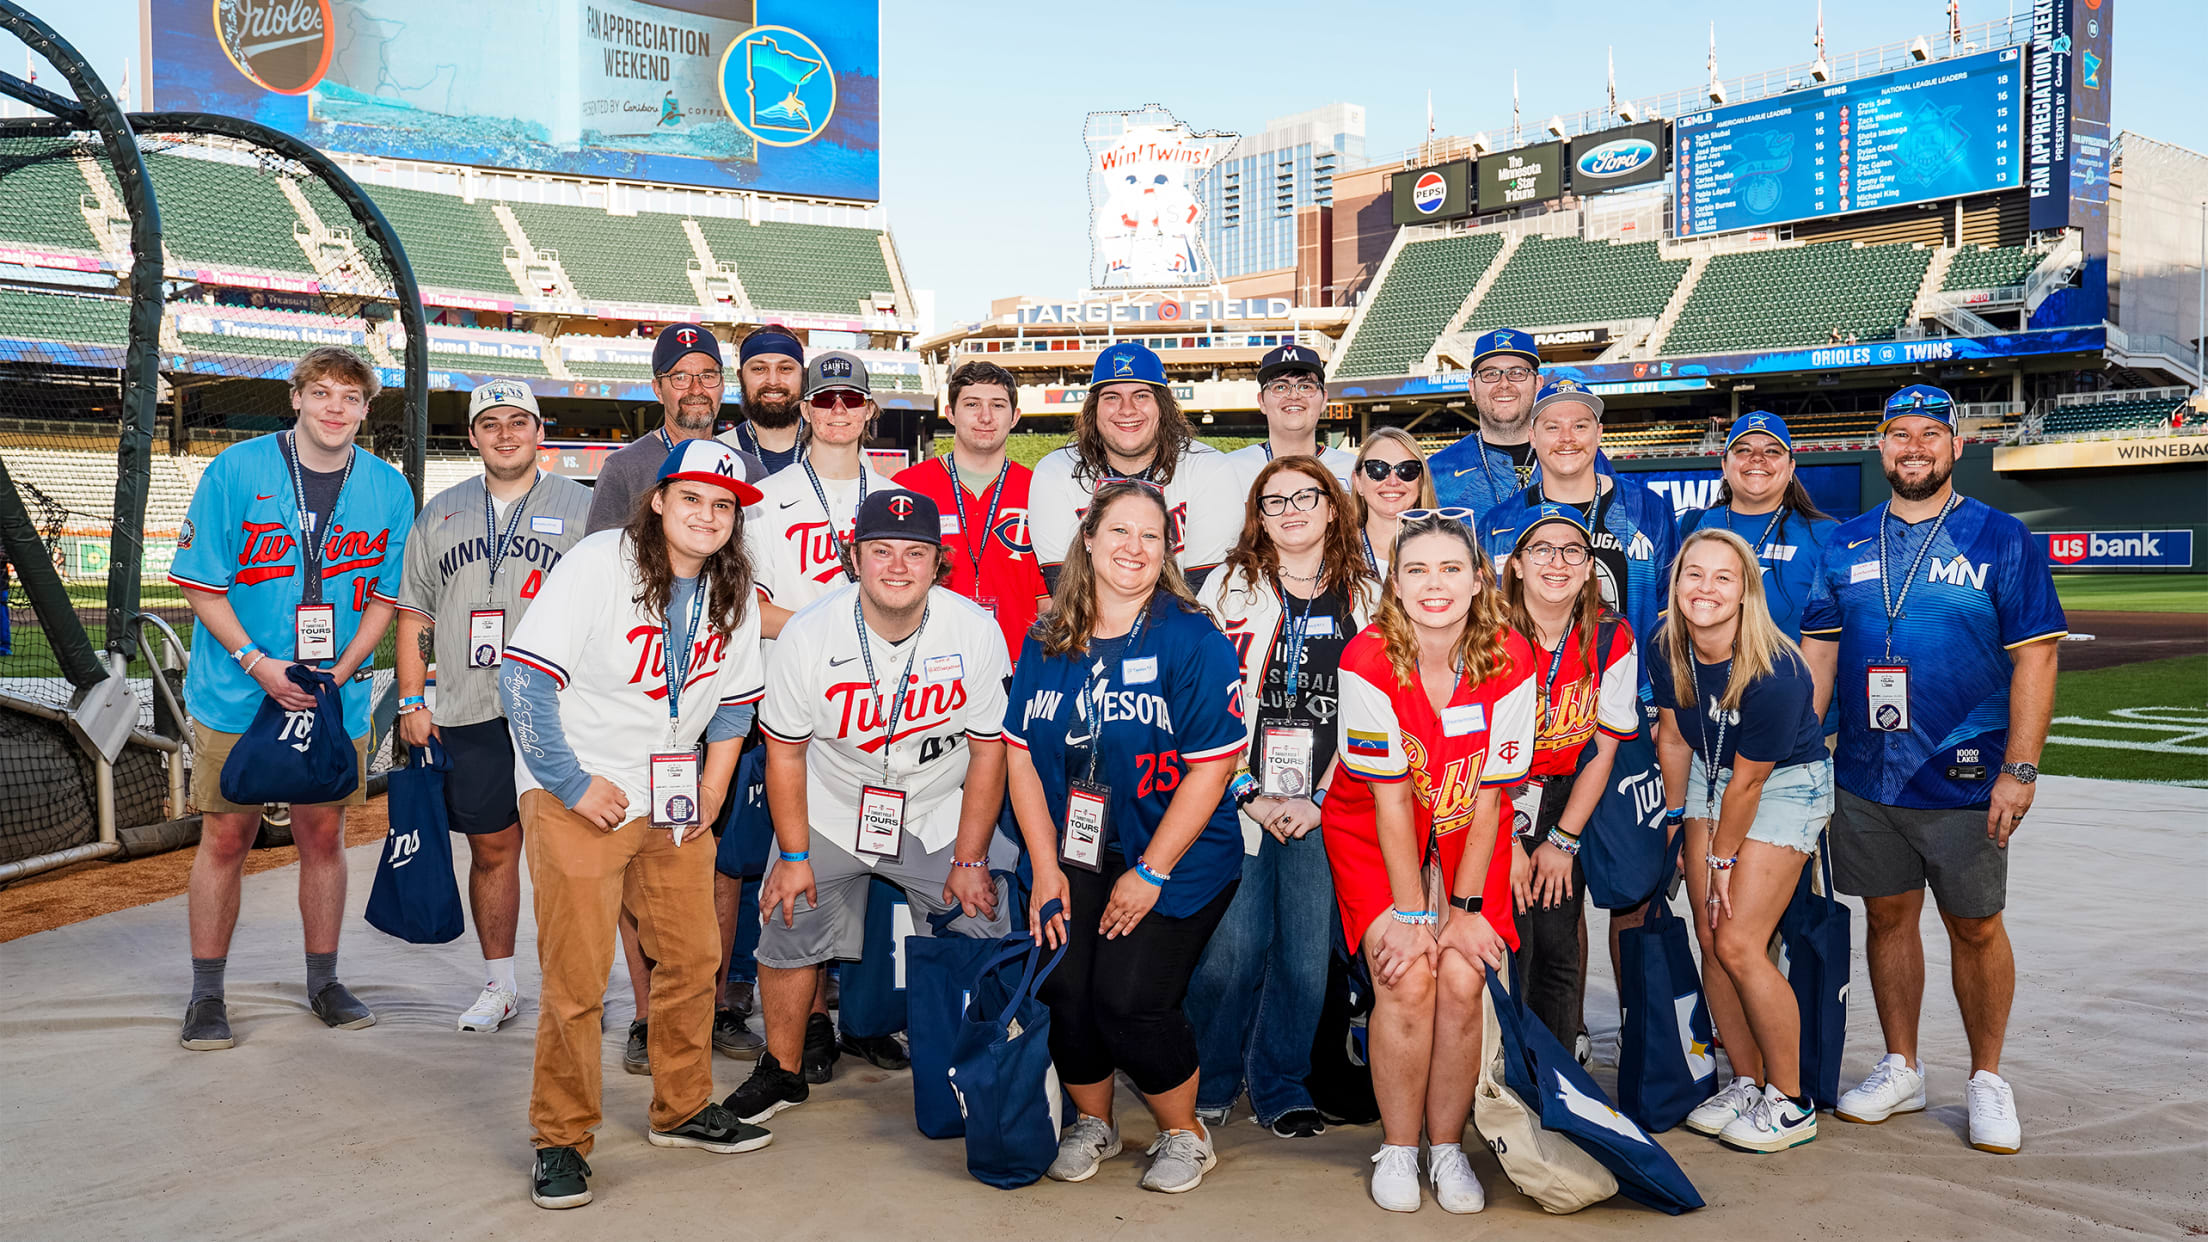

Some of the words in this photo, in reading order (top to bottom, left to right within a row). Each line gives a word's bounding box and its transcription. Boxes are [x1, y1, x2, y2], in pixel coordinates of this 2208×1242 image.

[587, 5, 601, 40] FAN
[602, 12, 710, 58] APPRECIATION
[2033, 0, 2053, 52] WEEK
[604, 47, 670, 82] WEEKEND
[1881, 83, 1912, 95] NATIONAL
[1912, 78, 1938, 90] LEAGUE
[1938, 72, 1968, 84] LEADERS
[1997, 75, 2008, 84] 18
[1824, 86, 1847, 97] WINS
[1997, 91, 2008, 100] 16
[1857, 102, 1876, 110] Chris
[1876, 98, 1892, 107] Sale
[2055, 92, 2065, 106] BY
[623, 100, 659, 113] Caribou
[1997, 107, 2008, 116] 15
[2031, 50, 2053, 164] APPRECIATION
[1691, 113, 1713, 126] MLB
[1716, 116, 1744, 129] AMERICAN
[1744, 112, 1766, 123] LEAGUE
[1766, 108, 1792, 119] LEADERS
[1815, 112, 1824, 121] 18
[1857, 117, 1874, 126] Zack
[1875, 111, 1904, 122] Wheeler
[1815, 126, 1824, 136] 16
[1857, 131, 1878, 141] Shota
[1878, 126, 1908, 137] Imanaga
[1997, 124, 2008, 134] 14
[2055, 106, 2065, 161] PRESENTED
[1815, 142, 1824, 151] 16
[1857, 138, 1873, 147] Cubs
[1997, 140, 2008, 150] 14
[1100, 144, 1143, 171] Win!
[1147, 140, 1210, 165] Twins!
[1857, 147, 1877, 157] Dylan
[1877, 143, 1899, 152] Cease
[1507, 156, 1523, 168] The
[1592, 148, 1640, 172] Ford
[1710, 160, 1725, 169] Lugo
[1815, 156, 1824, 166] 16
[1857, 163, 1872, 172] Zac
[1872, 159, 1893, 169] Gallen
[1997, 156, 2008, 166] 13
[1498, 163, 1542, 180] Minnesota
[1815, 172, 1824, 181] 15
[1997, 172, 2008, 182] 13
[1517, 177, 1536, 191] Star
[1857, 177, 1878, 188] Sonny
[1879, 174, 1896, 184] Gray
[2030, 166, 2050, 198] FAN
[1416, 188, 1444, 199] PEPSI
[1504, 187, 1535, 202] Tribune
[1815, 186, 1824, 196] 15
[1857, 192, 1883, 202] Michael
[1884, 188, 1900, 198] King
[1815, 202, 1824, 211] 15
[211, 272, 268, 288] Treasure
[269, 277, 308, 292] Island
[427, 293, 498, 310] Ticasino.com
[1016, 300, 1153, 323] TARGET
[1190, 298, 1292, 320] FIELD
[220, 321, 299, 341] Treasure
[301, 328, 353, 345] Island
[1534, 331, 1595, 345] RACISM
[468, 341, 499, 356] Run
[501, 344, 538, 359] Deck
[1281, 345, 1299, 363] M
[1811, 348, 1870, 366] ORIOLES
[1904, 342, 1953, 361] TWINS
[822, 361, 850, 371] SAINTS
[1441, 373, 1473, 384] APPREC
[1631, 382, 1659, 392] COVE
[714, 458, 734, 478] M
[238, 520, 390, 566] Twins
[2052, 537, 2084, 559] us
[2089, 533, 2160, 558] bank
[1926, 556, 1991, 590] MN
[626, 624, 726, 684] Twin
[824, 674, 968, 740] Twins
[1956, 748, 1980, 756] 10000
[1268, 756, 1305, 765] TOURS
[1956, 756, 1979, 764] LAKES
[1136, 750, 1181, 799] 25
[1617, 762, 1668, 830] Twi
[864, 814, 899, 827] TOURS
[1070, 819, 1099, 833] TOURS
[388, 827, 420, 870] ins
